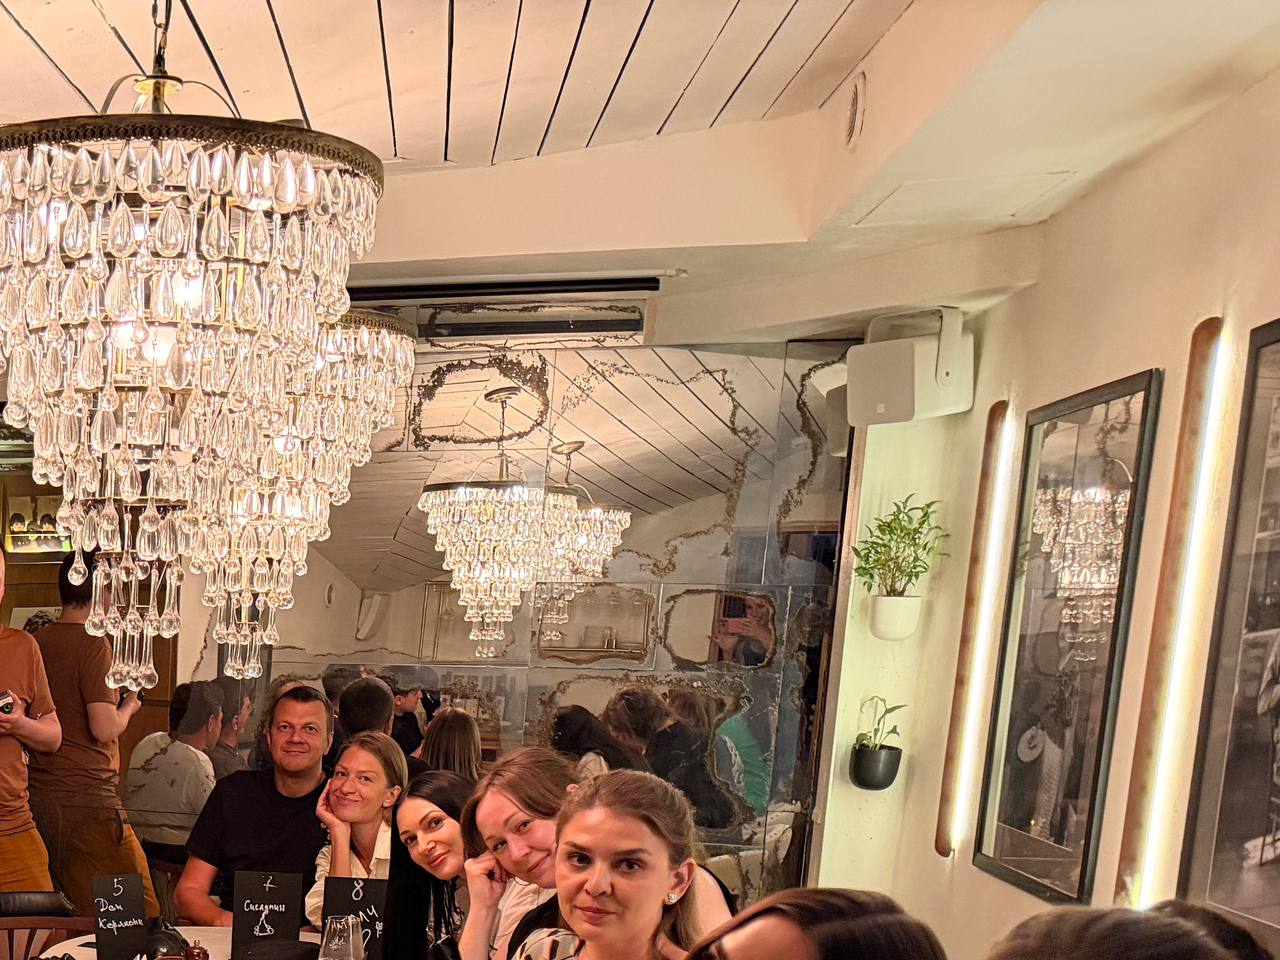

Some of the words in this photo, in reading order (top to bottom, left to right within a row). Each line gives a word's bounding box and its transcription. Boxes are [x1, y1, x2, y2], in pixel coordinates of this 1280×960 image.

[112, 877, 125, 897] 5
[260, 875, 278, 892] 7
[351, 879, 365, 901] 8
